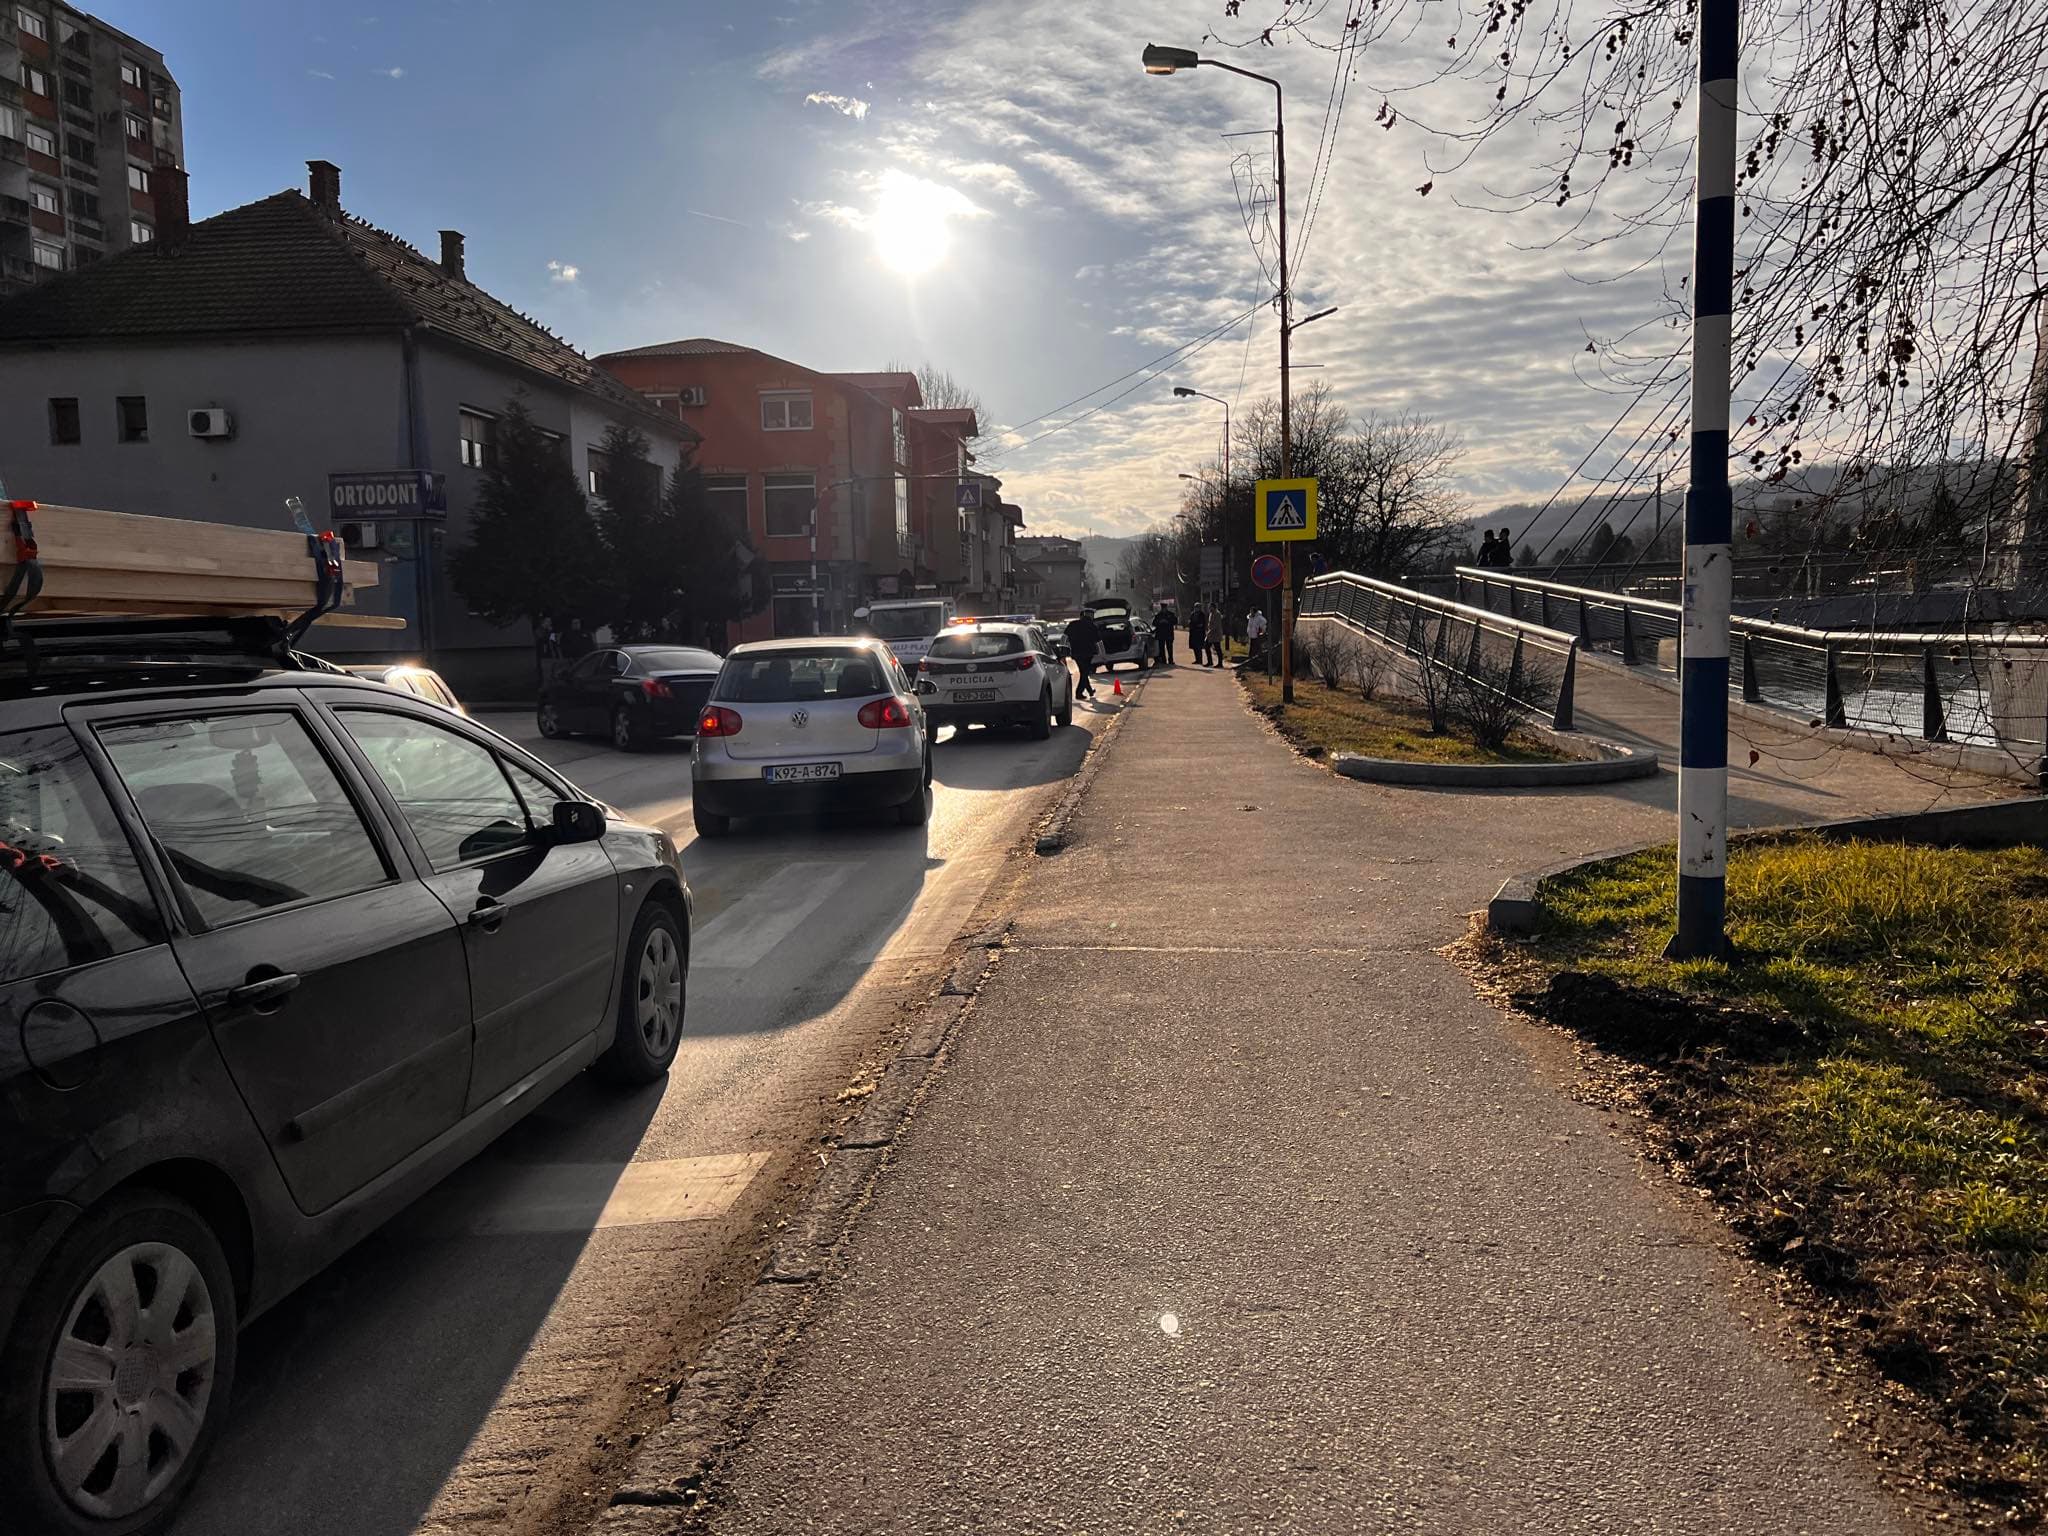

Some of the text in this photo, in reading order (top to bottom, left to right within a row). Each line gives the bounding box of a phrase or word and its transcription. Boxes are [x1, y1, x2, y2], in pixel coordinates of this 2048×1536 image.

[334, 483, 418, 506] ORTODONT
[950, 676, 994, 684] POLICIJA
[774, 764, 837, 780] K92-A-874
